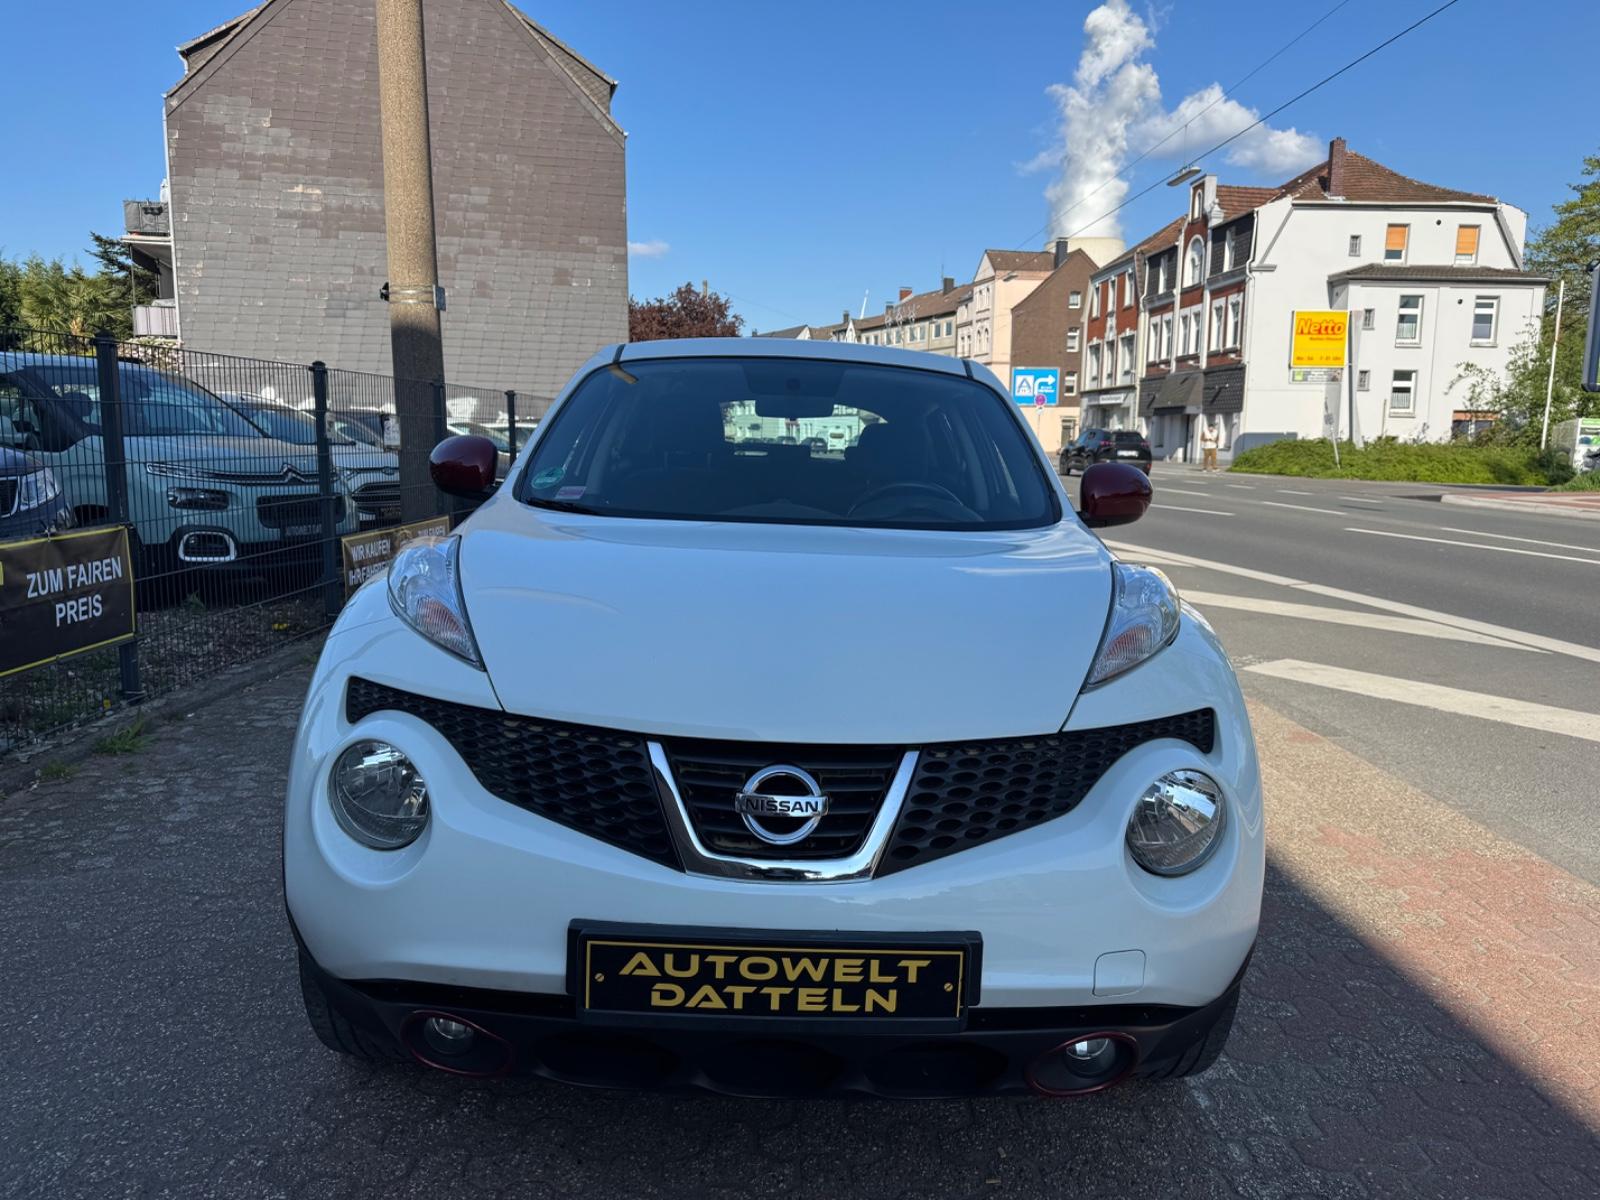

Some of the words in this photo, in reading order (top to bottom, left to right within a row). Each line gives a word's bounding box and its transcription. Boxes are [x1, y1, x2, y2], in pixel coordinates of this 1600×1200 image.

[1296, 318, 1345, 335] Netto
[351, 544, 365, 561] WIR
[365, 538, 391, 559] KAUFEN
[26, 567, 64, 598] ZUM
[66, 556, 123, 590] FAIREN
[55, 594, 103, 627] PREIS
[745, 799, 819, 813] NISSAN
[618, 951, 932, 984] AUTOWELT
[650, 983, 897, 1013] DATTELN
